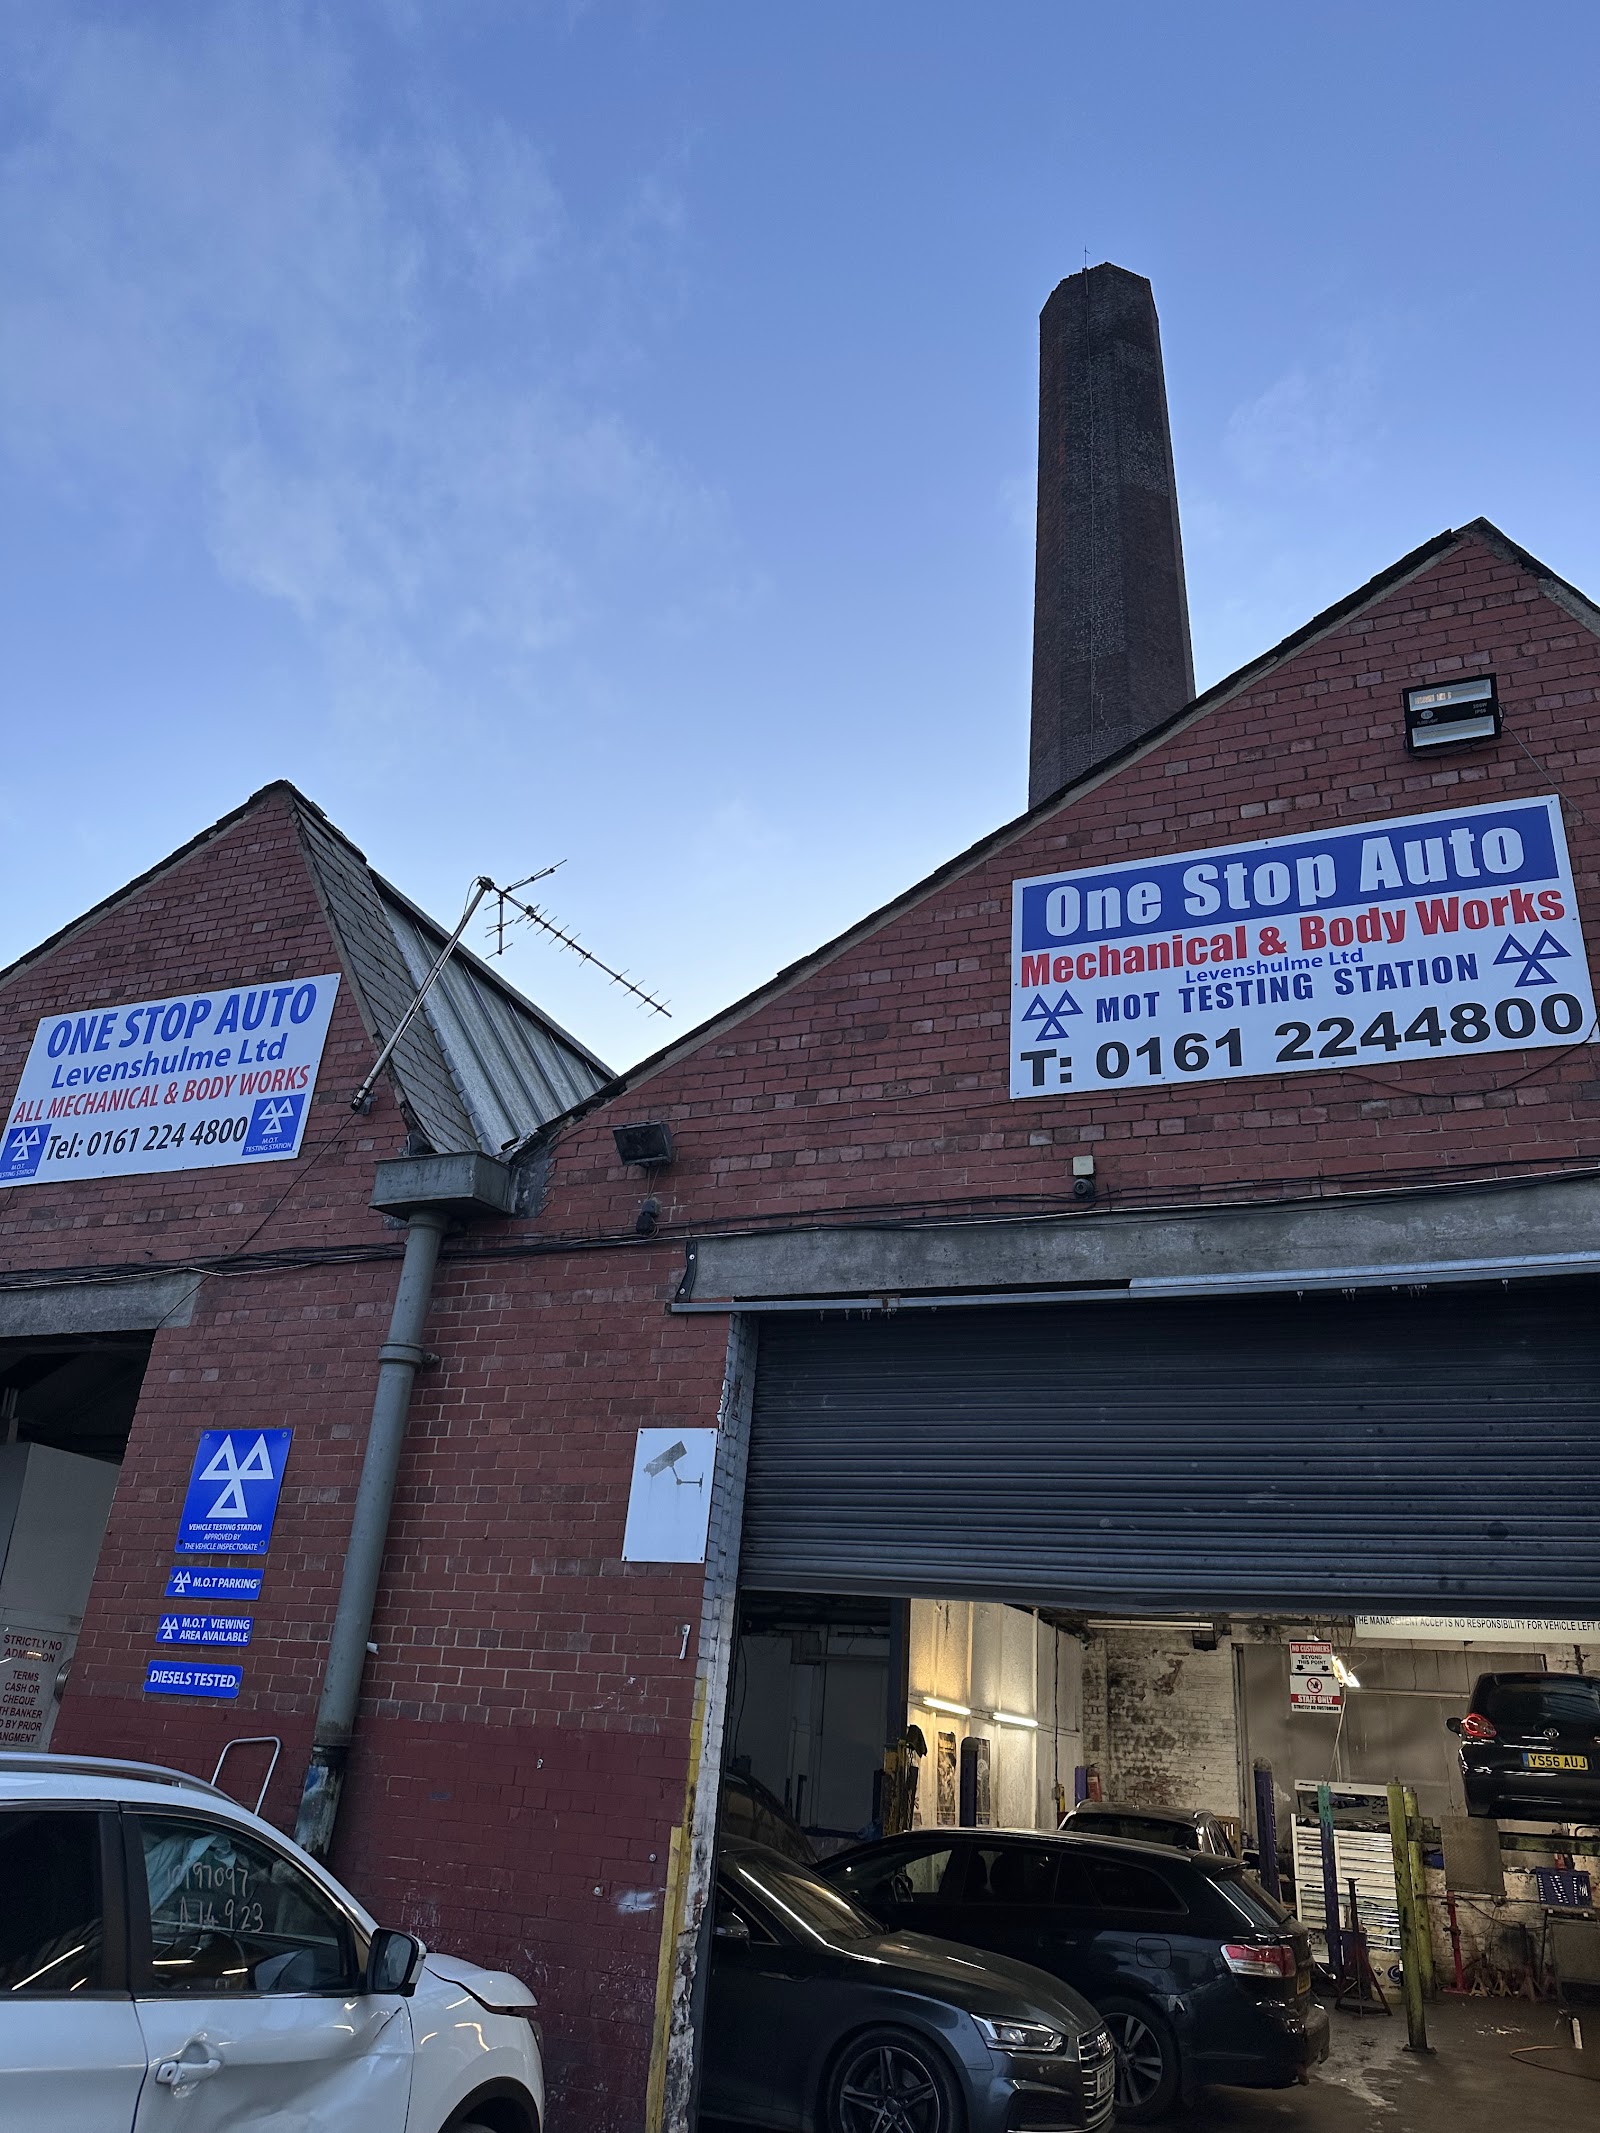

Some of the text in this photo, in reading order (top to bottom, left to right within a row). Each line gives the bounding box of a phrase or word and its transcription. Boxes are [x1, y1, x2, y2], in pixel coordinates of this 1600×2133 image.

[1045, 826, 1524, 937] One Stop Auto
[1021, 889, 1566, 988] Mechanical & Body Works
[1185, 948, 1364, 984] Levenshulme Ltd
[1095, 953, 1479, 1024] MOT TESTING STATION
[47, 983, 318, 1058] ONE STOP AUTO
[1021, 993, 1585, 1088] T: 0161 2244800
[51, 1033, 288, 1089] Levenshulme Ltd
[12, 1064, 311, 1124] ALL MECHANICAL & BODY WORKS
[46, 1116, 248, 1161] Tel: 0161 224 4800
[245, 1142, 292, 1152] TESTING STATION
[189, 1523, 212, 1531] VEHICLE
[212, 1523, 236, 1531] TESTING
[204, 1533, 233, 1541] APPROVED
[184, 1542, 195, 1550] THE
[195, 1542, 216, 1550] VEHICLE
[193, 1576, 257, 1589] M.O.T PARKING
[182, 1617, 250, 1630] M.O.T VIEWING
[1354, 1615, 1368, 1625] THE
[1420, 1617, 1453, 1628] ACCEPTS
[1454, 1618, 1465, 1628] NO
[1467, 1618, 1526, 1629] RESPONSIBILITY
[1527, 1620, 1543, 1630] FOR
[1544, 1620, 1576, 1631] VEHICLE
[1578, 1621, 1597, 1631] LEFT
[4, 1634, 62, 1651] STRICTLY NO
[179, 1630, 249, 1643] AREA AVAILABLE
[1300, 1645, 1330, 1653] CUSTOMERS
[13, 1670, 39, 1681] TERMS
[150, 1669, 236, 1688] DIESELS TESTED
[4, 1682, 40, 1694] CASH OR
[2, 1694, 36, 1706] CHEQUE
[1297, 1694, 1333, 1704] STAFF ONLY
[10, 1707, 42, 1719] BANKER
[5, 1719, 17, 1729] BY
[17, 1720, 42, 1732] PRIOR
[1530, 1754, 1586, 1769] YS56 AUJ
